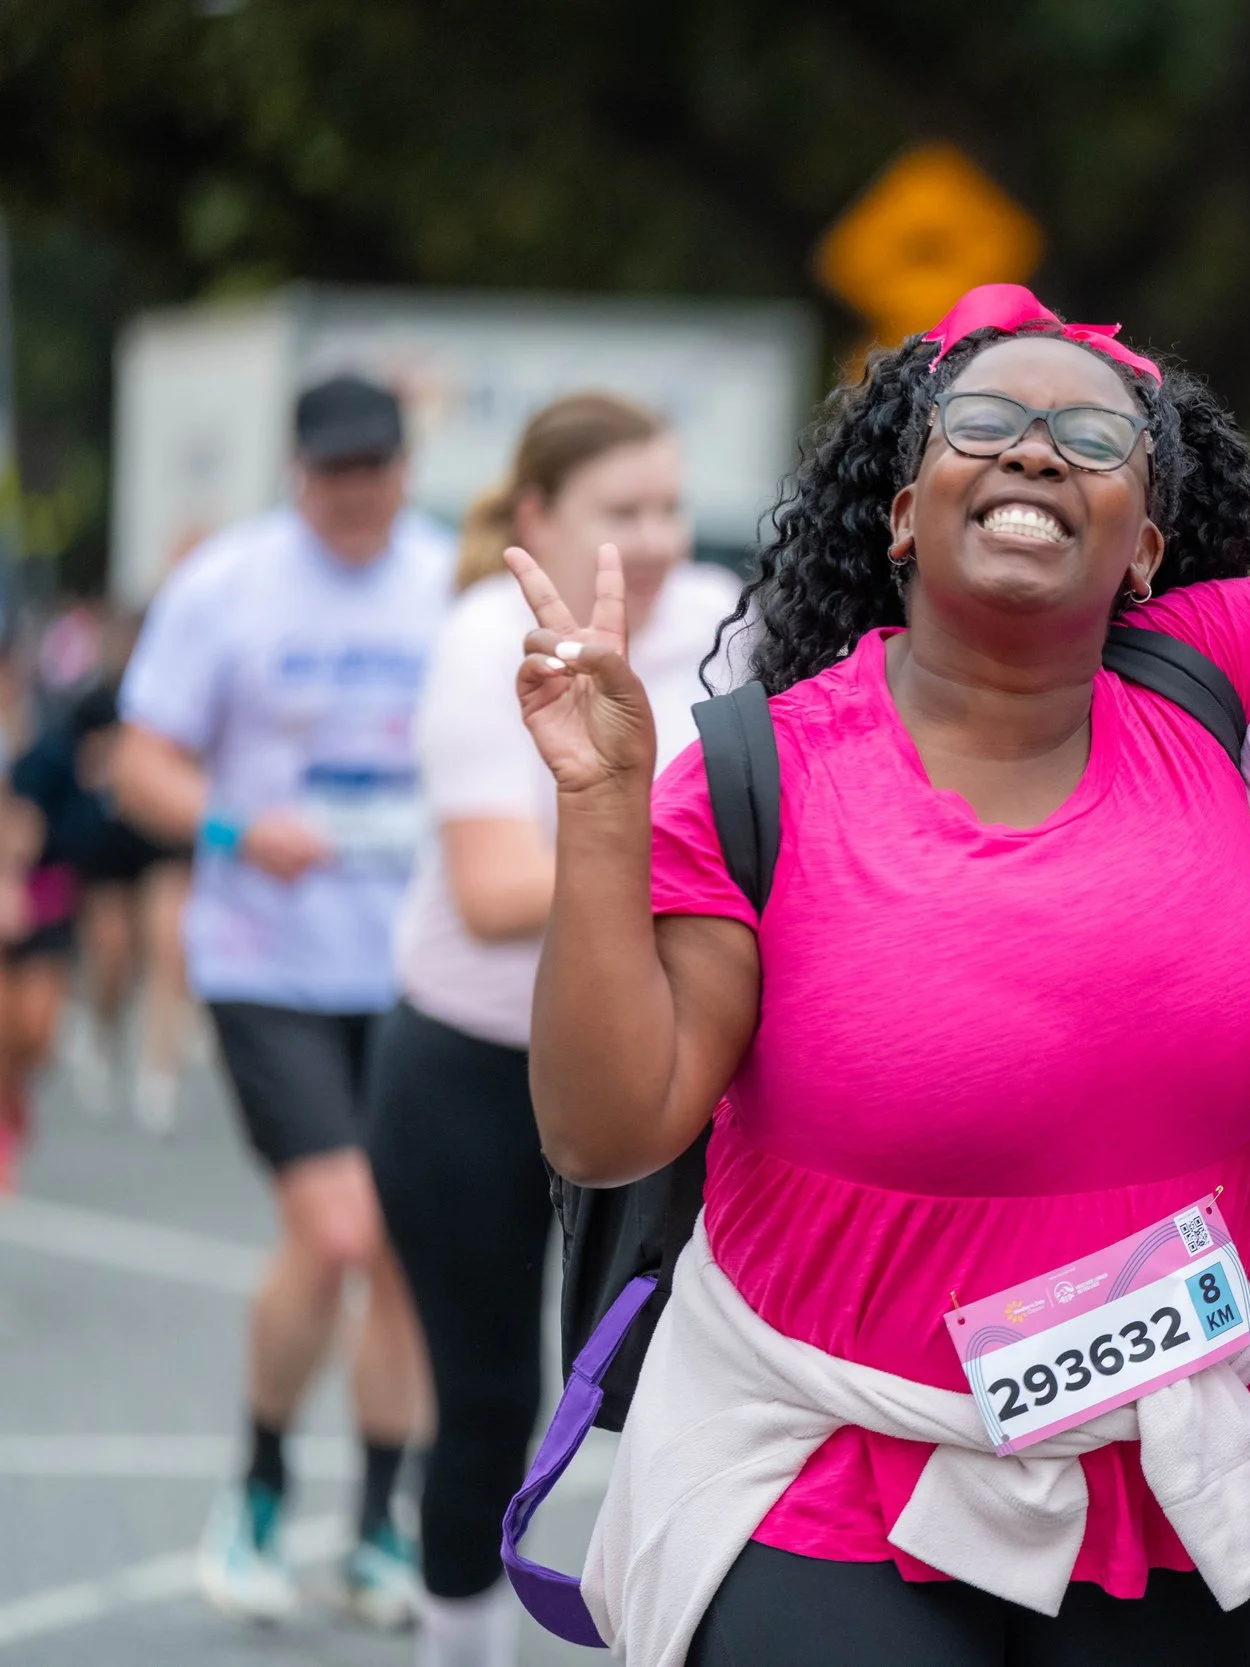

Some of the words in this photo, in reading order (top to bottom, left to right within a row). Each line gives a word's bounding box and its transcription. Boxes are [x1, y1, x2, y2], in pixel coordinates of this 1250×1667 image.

[1198, 1272, 1222, 1304] 8
[1206, 1304, 1235, 1331] KM
[987, 1306, 1191, 1423] 293632
